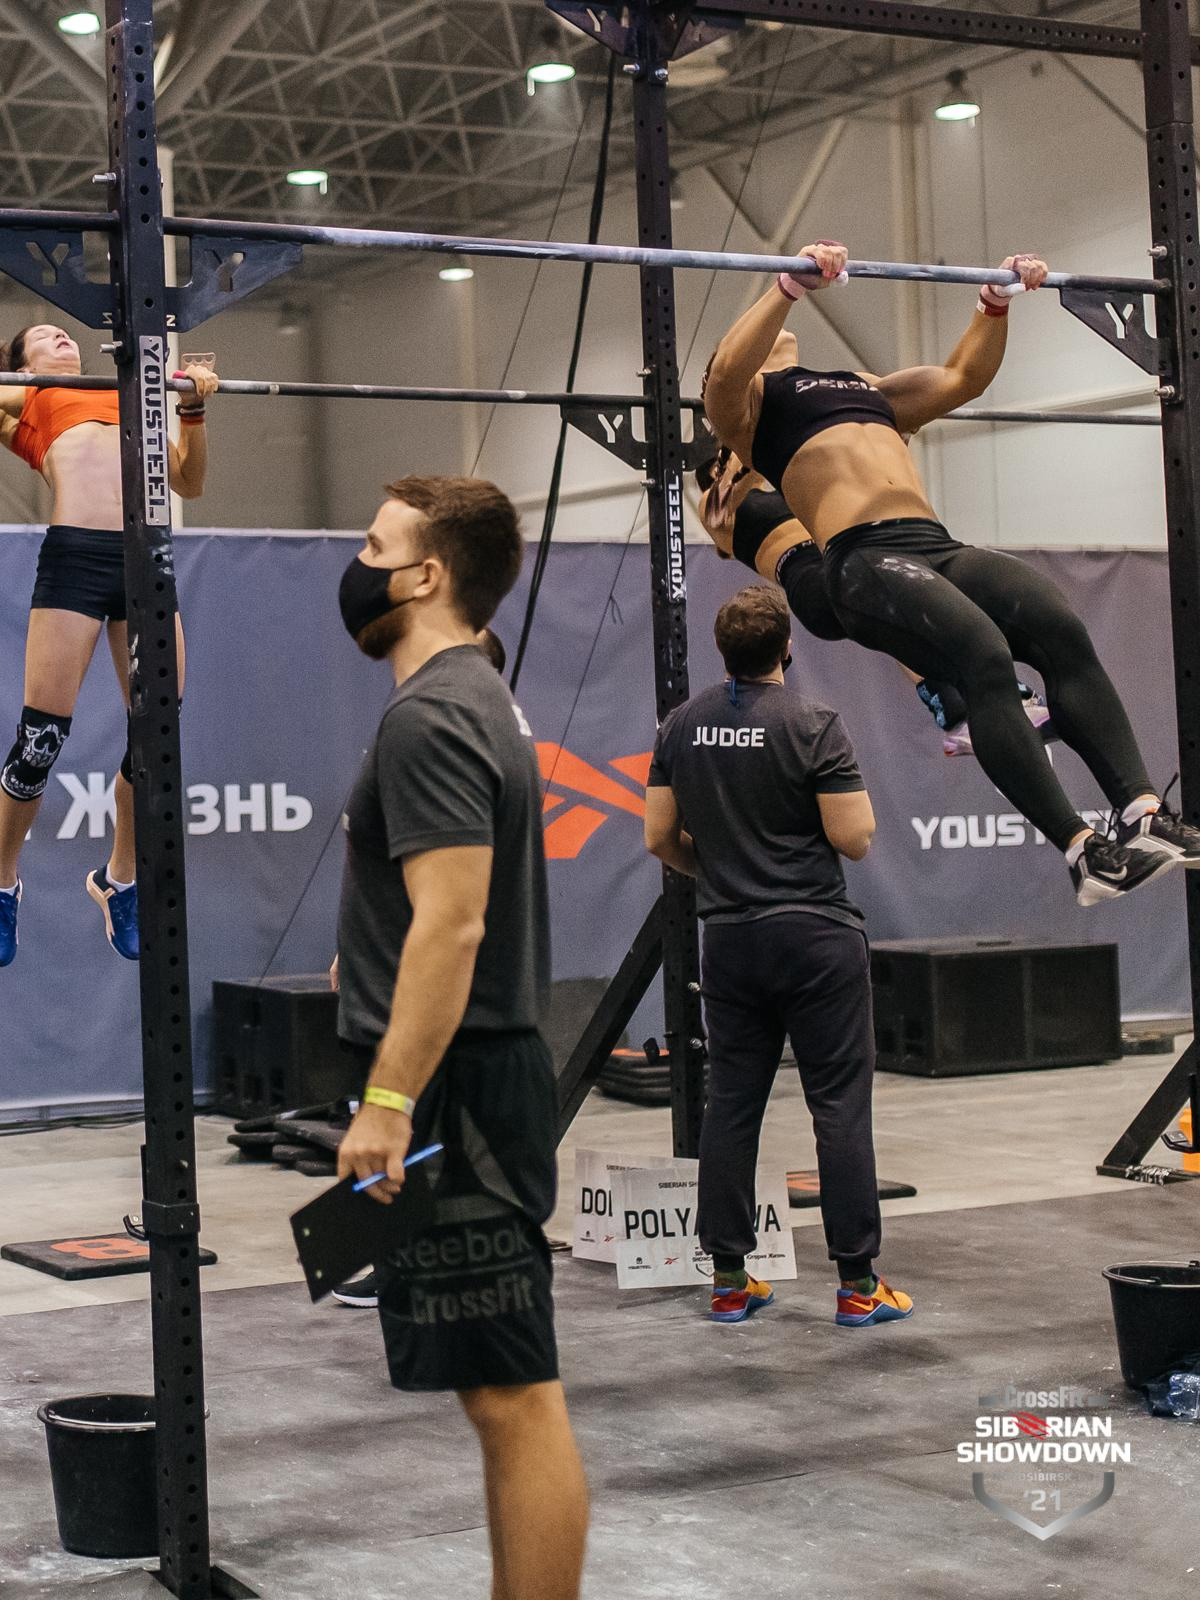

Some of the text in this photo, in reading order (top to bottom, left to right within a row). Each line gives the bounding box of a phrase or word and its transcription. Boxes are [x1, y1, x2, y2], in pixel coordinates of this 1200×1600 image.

[143, 342, 166, 519] YOUSTEEL
[668, 474, 686, 600] YOUSTEEL
[692, 726, 766, 748] JUDGE
[56, 772, 314, 840] Жзнь
